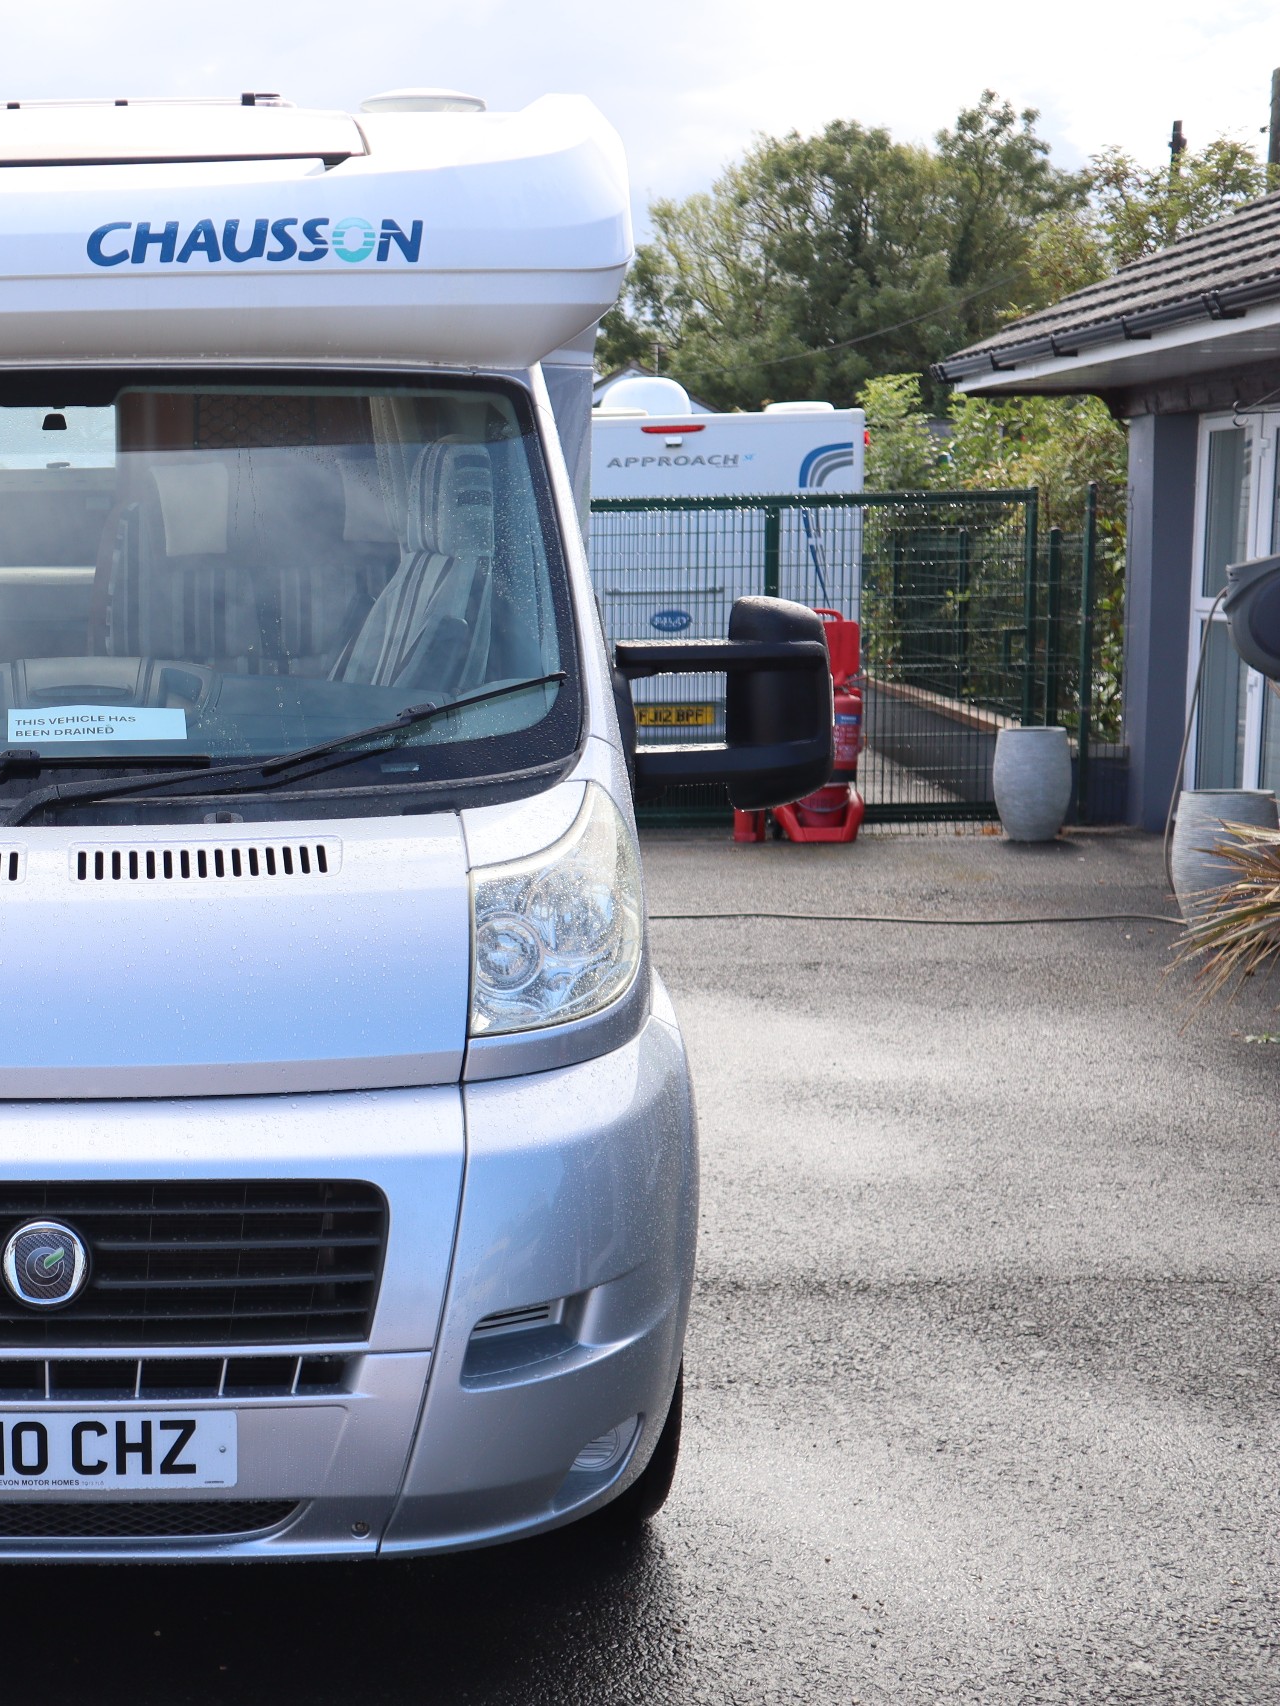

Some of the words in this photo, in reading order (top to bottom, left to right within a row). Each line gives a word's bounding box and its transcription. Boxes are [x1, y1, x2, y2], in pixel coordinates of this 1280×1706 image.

[86, 216, 423, 267] CHAUSSON
[606, 454, 740, 468] APPROACH
[15, 718, 46, 726] THIS
[48, 715, 105, 725] VEHICLE
[108, 715, 136, 723] HAS
[639, 708, 672, 723] FJ12
[676, 708, 704, 722] BPF
[15, 729, 50, 737] BEEN
[54, 726, 114, 737] DRAINED
[72, 1420, 197, 1476] CHZ
